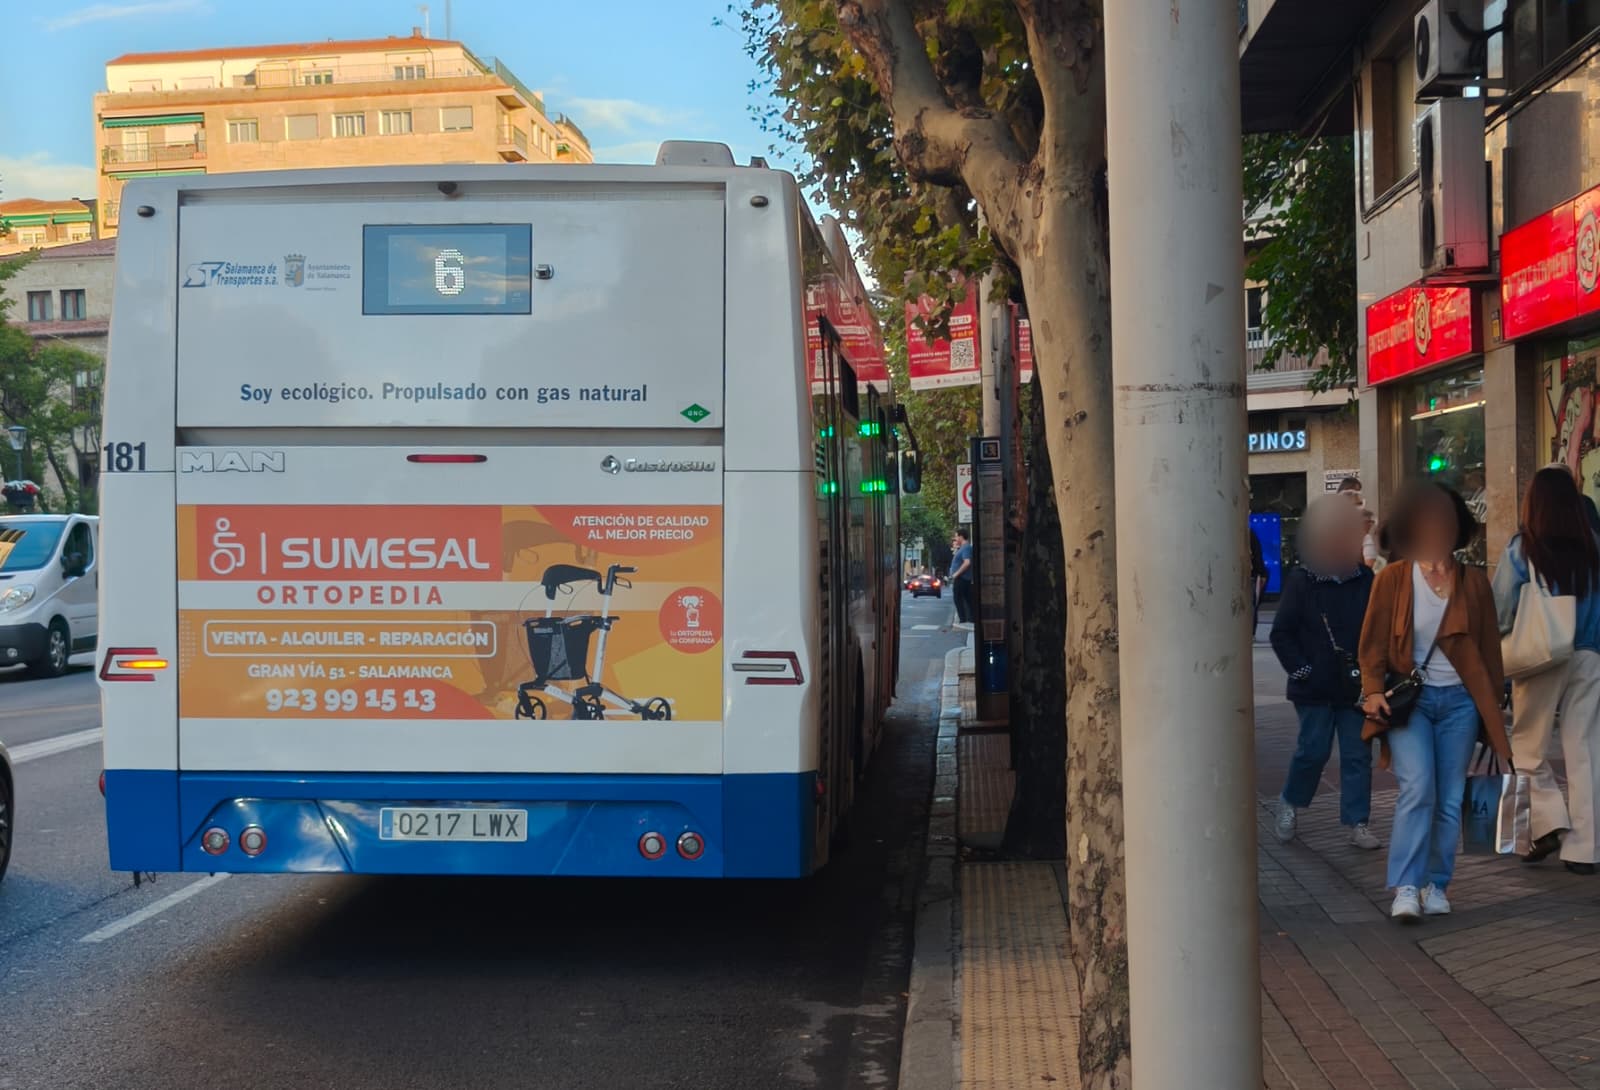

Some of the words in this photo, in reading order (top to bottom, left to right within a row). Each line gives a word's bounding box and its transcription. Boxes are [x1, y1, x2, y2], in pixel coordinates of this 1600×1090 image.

[224, 262, 266, 275] Salamanca
[266, 262, 277, 275] de
[307, 263, 351, 272] Ayuntamiento
[317, 272, 351, 280] Salamanca
[434, 248, 465, 296] 6
[217, 274, 263, 288] Transportes
[264, 275, 279, 286] s.a.
[239, 383, 273, 404] Soy
[280, 382, 374, 403] ecológico.
[382, 382, 487, 403] Propulsado
[495, 386, 529, 401] con
[537, 386, 571, 404] gas
[579, 384, 648, 402] natural
[1248, 430, 1306, 451] PINOS
[103, 442, 146, 472] 181
[181, 451, 286, 473] MAN
[572, 513, 635, 527] ATENCIÓN
[637, 516, 654, 527] DE
[655, 516, 709, 527] CALIDAD
[587, 529, 604, 540] AL
[606, 529, 647, 540] MEJOR
[649, 529, 694, 540] PRECIO
[280, 538, 491, 570] SUMESAL
[256, 585, 444, 606] ORTOPEDIA
[211, 631, 268, 646] VENTA
[280, 631, 365, 647] ALQUILER
[379, 628, 489, 647] REPARACIÓN
[247, 664, 295, 678] GRAN
[299, 661, 326, 678] VÍA
[328, 666, 346, 680] 51
[358, 666, 453, 679] SALAMANCA
[265, 688, 317, 712] 923
[323, 689, 358, 712] 99
[364, 688, 397, 712] 15
[403, 688, 437, 712] 13
[399, 812, 461, 836] 0217
[472, 813, 520, 837] LWX
